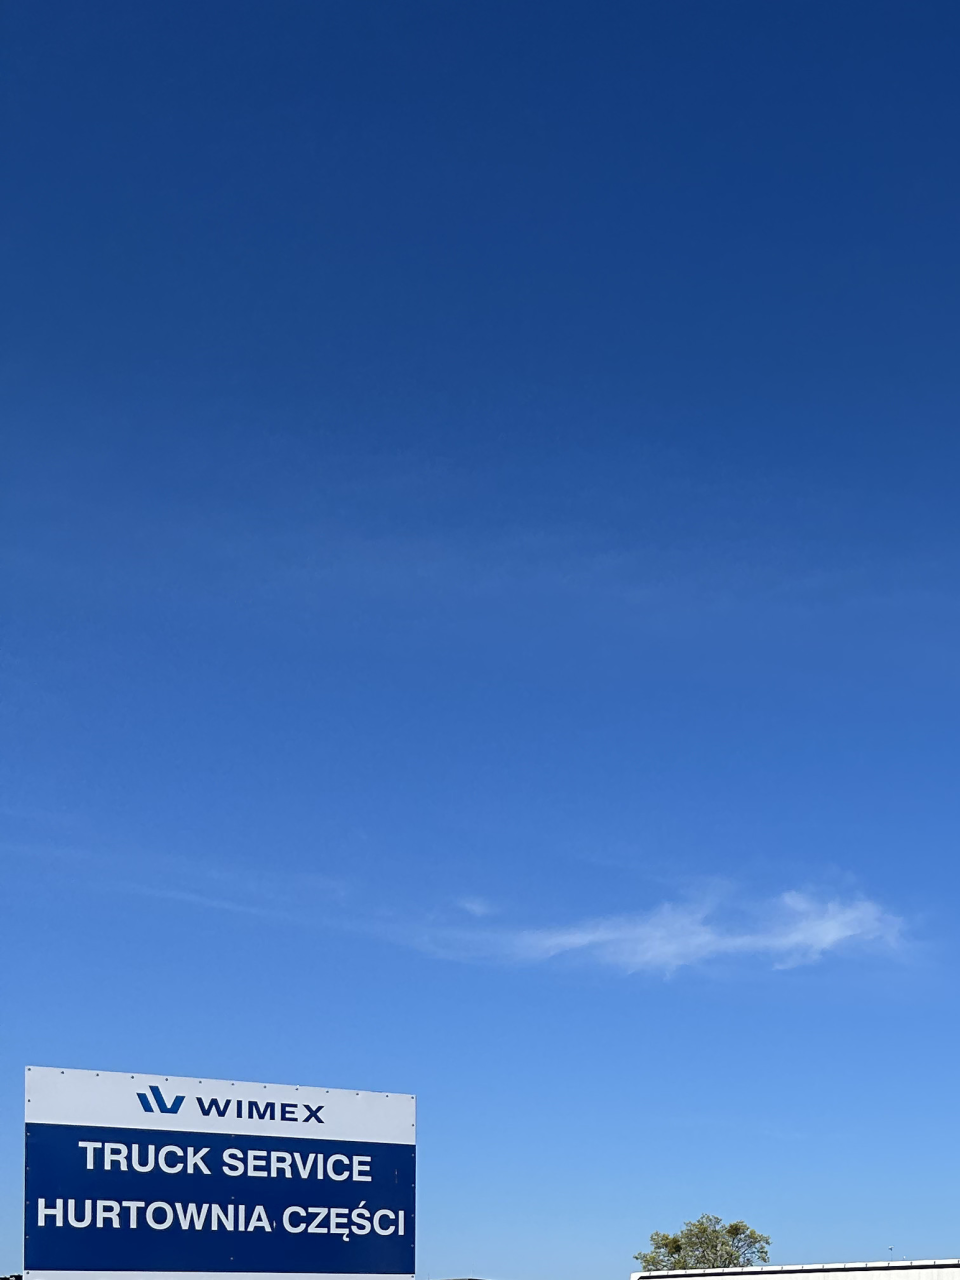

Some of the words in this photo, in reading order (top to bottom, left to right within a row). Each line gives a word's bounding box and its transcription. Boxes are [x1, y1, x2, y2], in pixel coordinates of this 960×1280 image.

[195, 1095, 325, 1124] WIMEX
[78, 1140, 212, 1175] TRUCK
[222, 1148, 372, 1182] SERVICE
[37, 1197, 273, 1232] HURTOWNIA
[282, 1200, 405, 1242] CZĘŚCI
